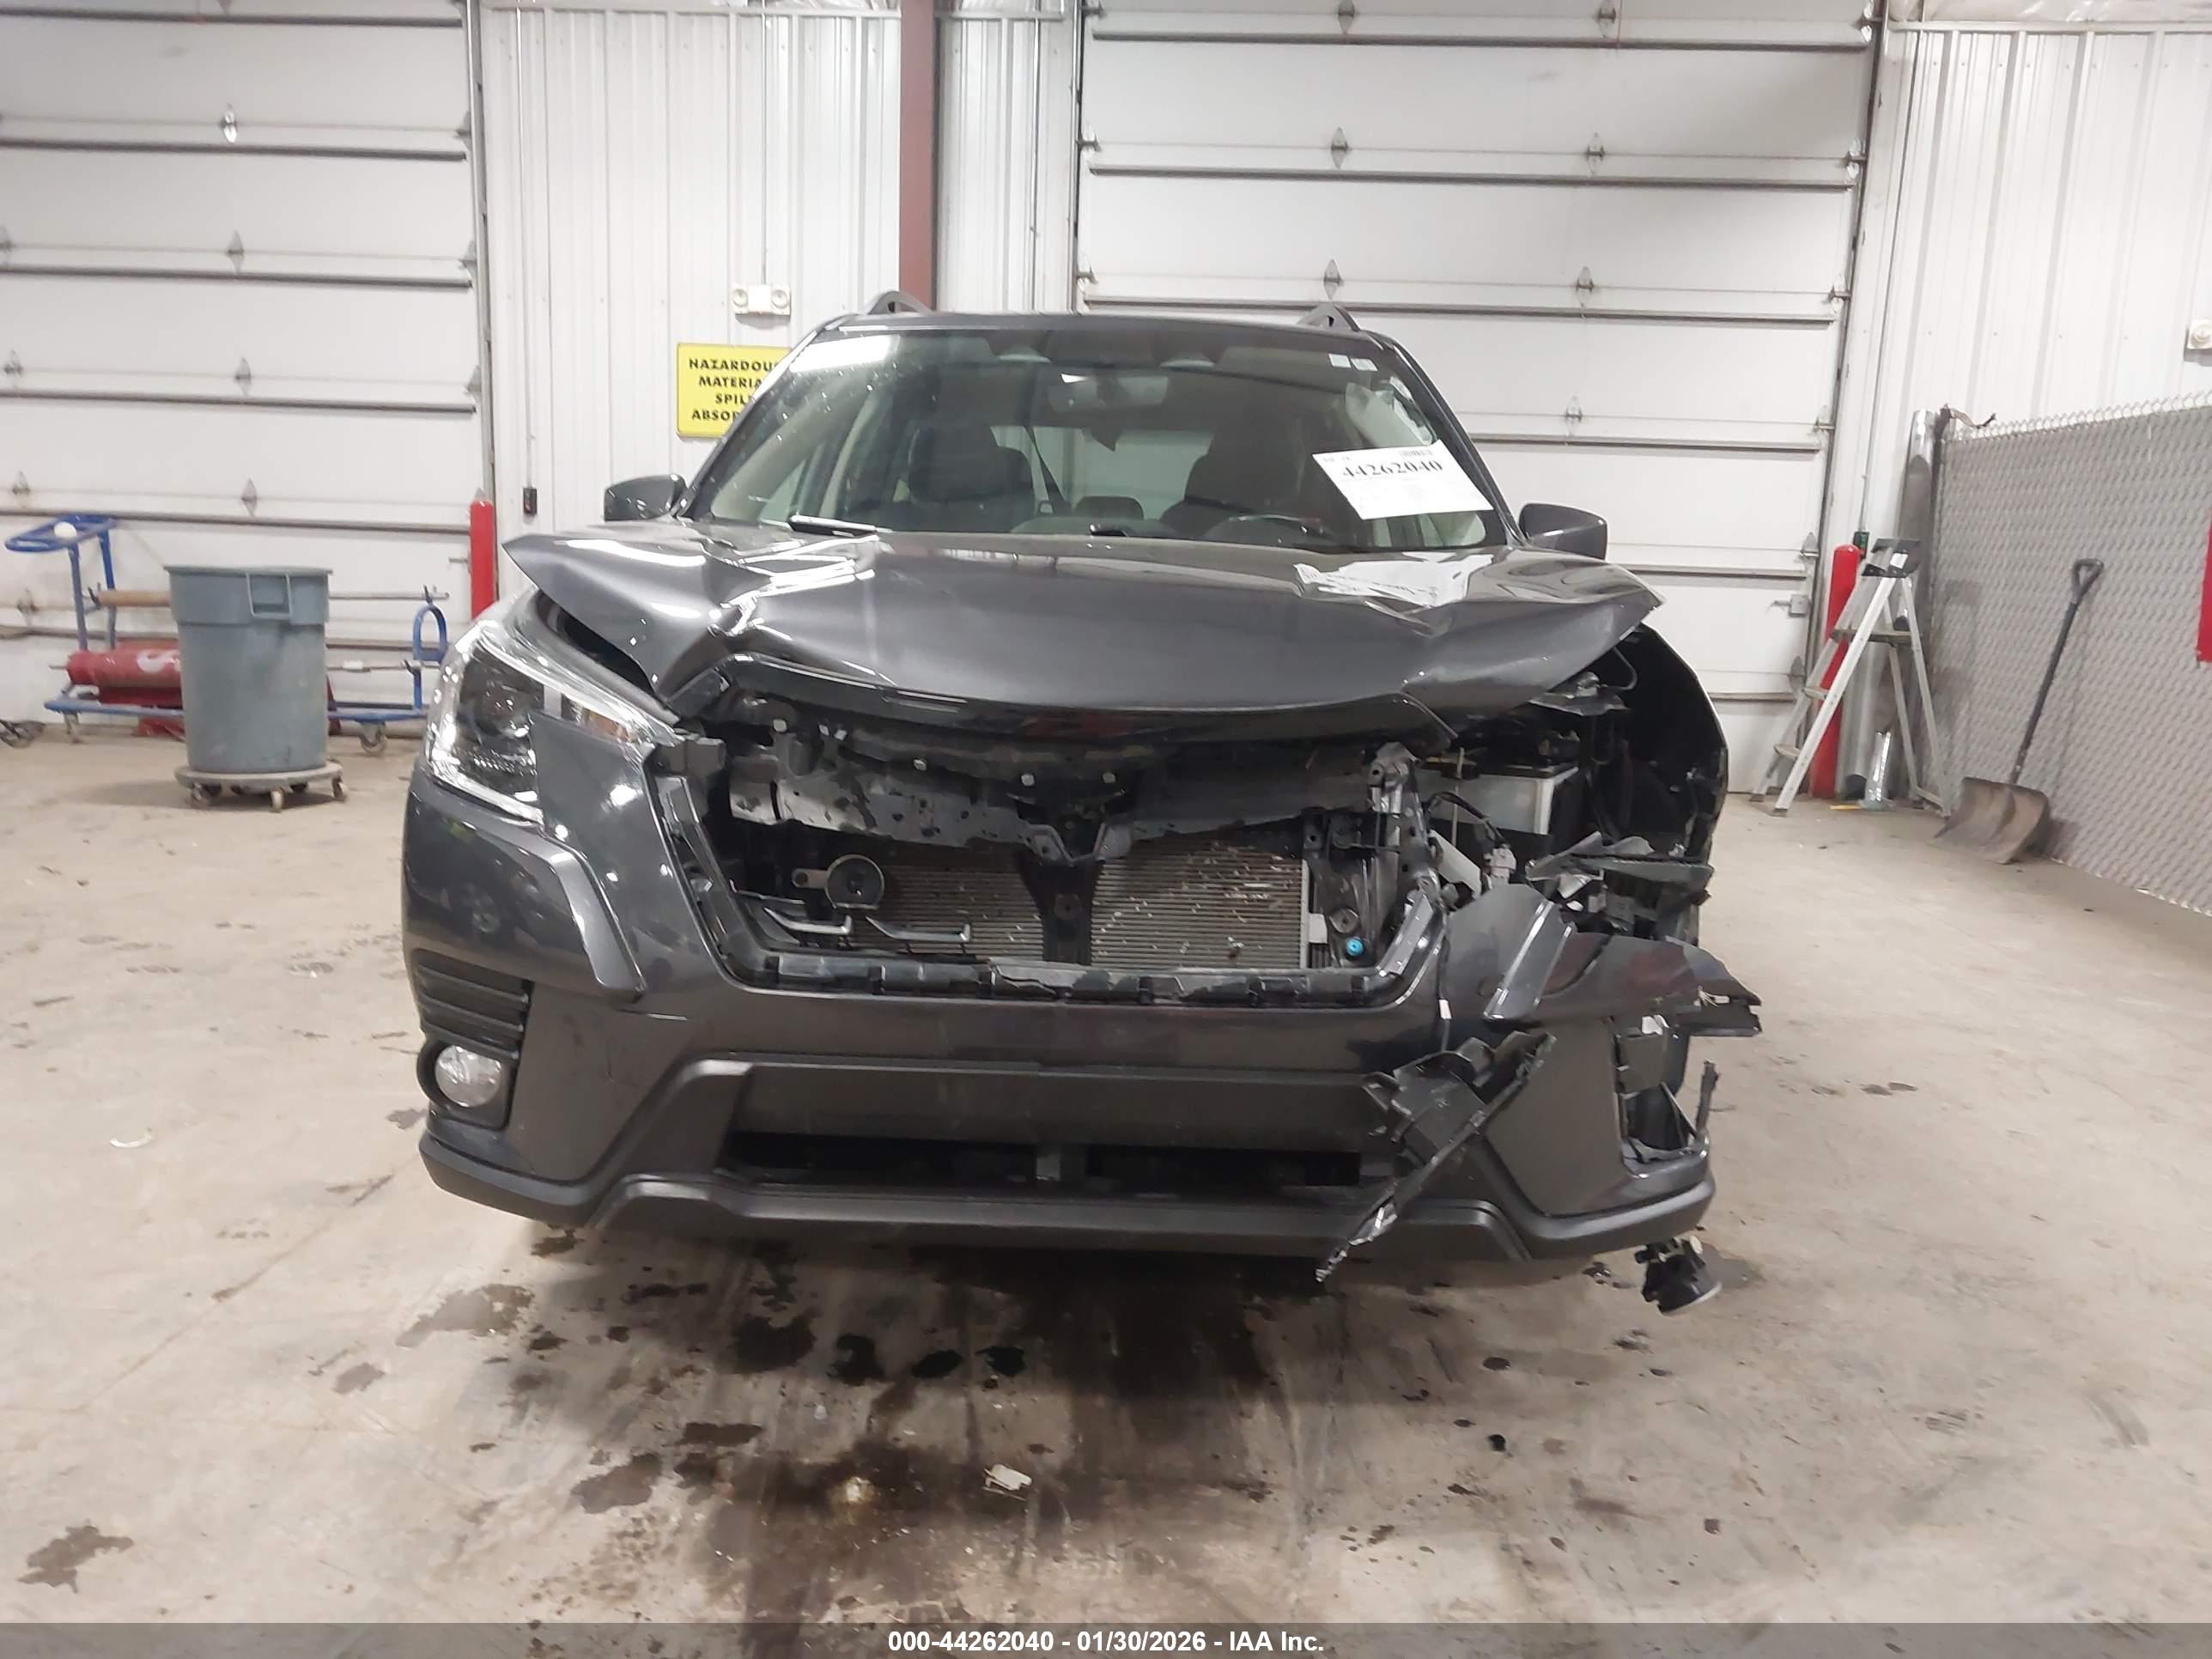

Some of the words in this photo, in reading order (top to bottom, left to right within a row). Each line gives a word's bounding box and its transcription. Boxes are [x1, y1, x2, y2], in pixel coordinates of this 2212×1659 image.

[689, 358, 778, 371] HAZARDOU
[715, 393, 752, 405] SPIL
[1342, 460, 1443, 477] 44262040
